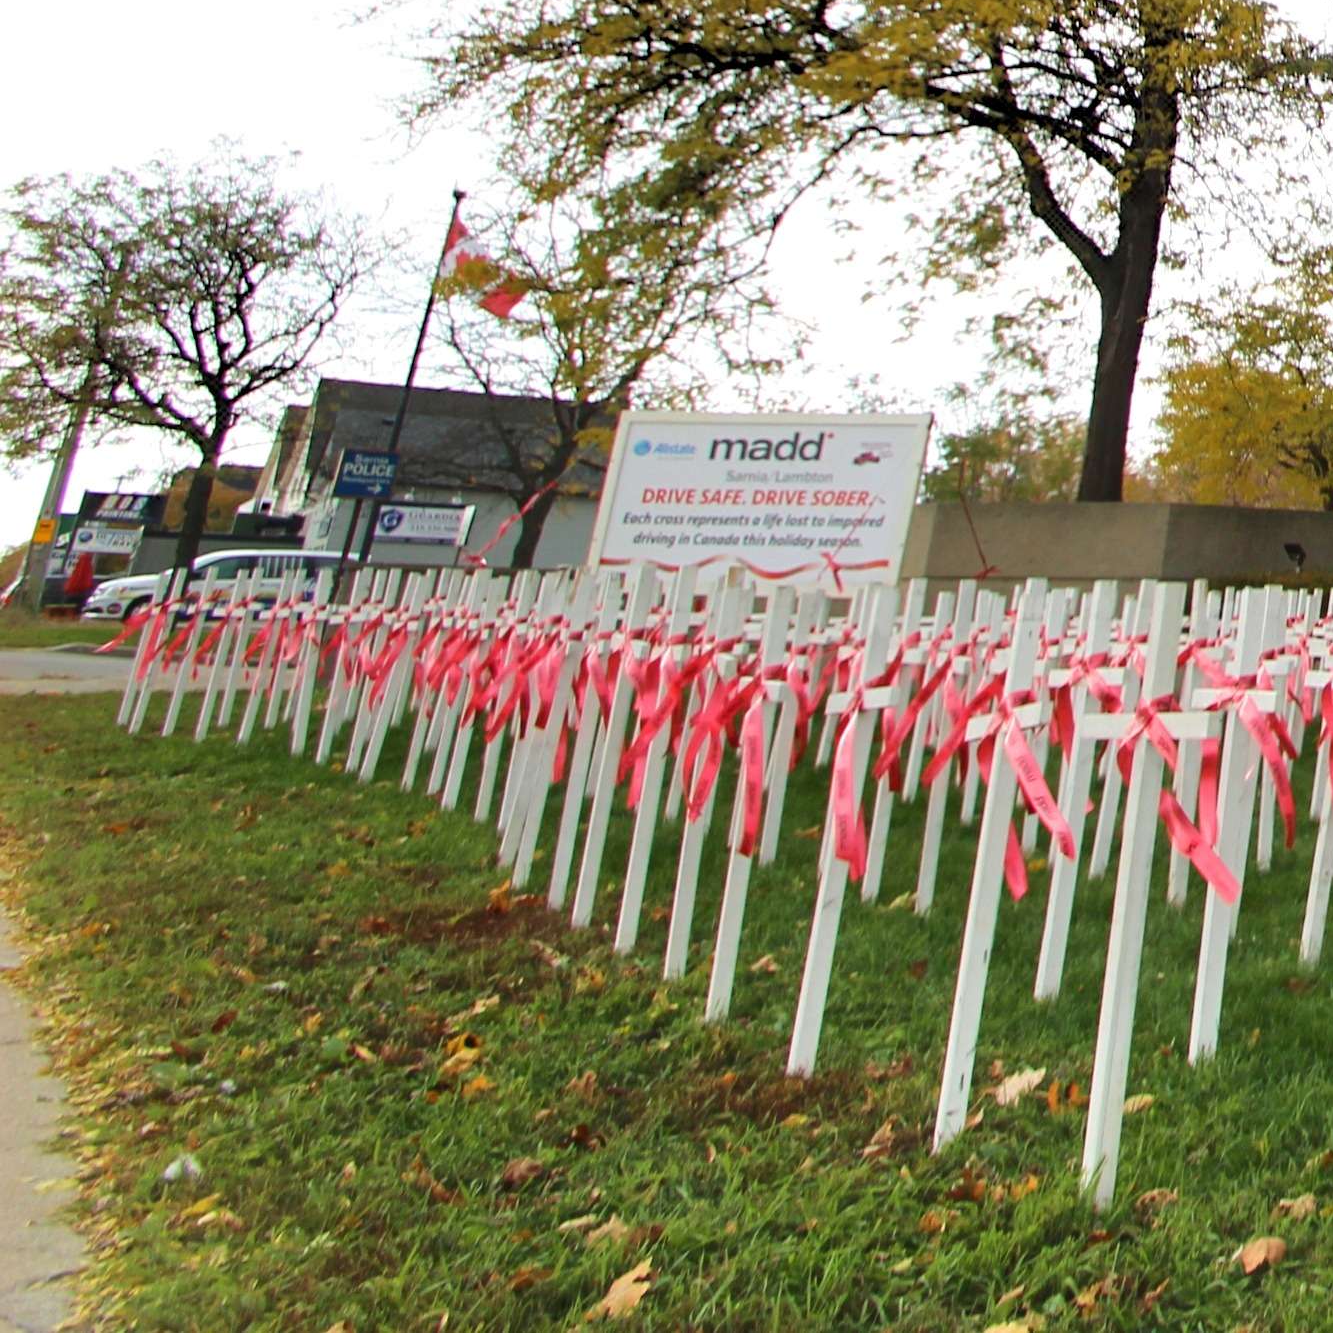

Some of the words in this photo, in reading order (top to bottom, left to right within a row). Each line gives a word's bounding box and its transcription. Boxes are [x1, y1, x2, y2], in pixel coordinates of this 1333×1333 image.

[708, 432, 825, 462] madd
[343, 462, 395, 477] POLICE
[641, 488, 696, 505] DRIVE
[699, 489, 746, 506] SAFE.
[752, 489, 807, 506] DRIVE
[623, 512, 652, 525] Each
[654, 515, 684, 525] cross
[687, 515, 750, 528] represents
[752, 516, 761, 526] a
[762, 513, 783, 529] life
[785, 514, 809, 527] lost
[812, 515, 827, 527] to
[827, 514, 886, 530] impaired
[633, 531, 676, 548] driving
[678, 532, 691, 545] in
[693, 532, 740, 546] Canada
[742, 532, 767, 546] this
[768, 533, 817, 549] holiday
